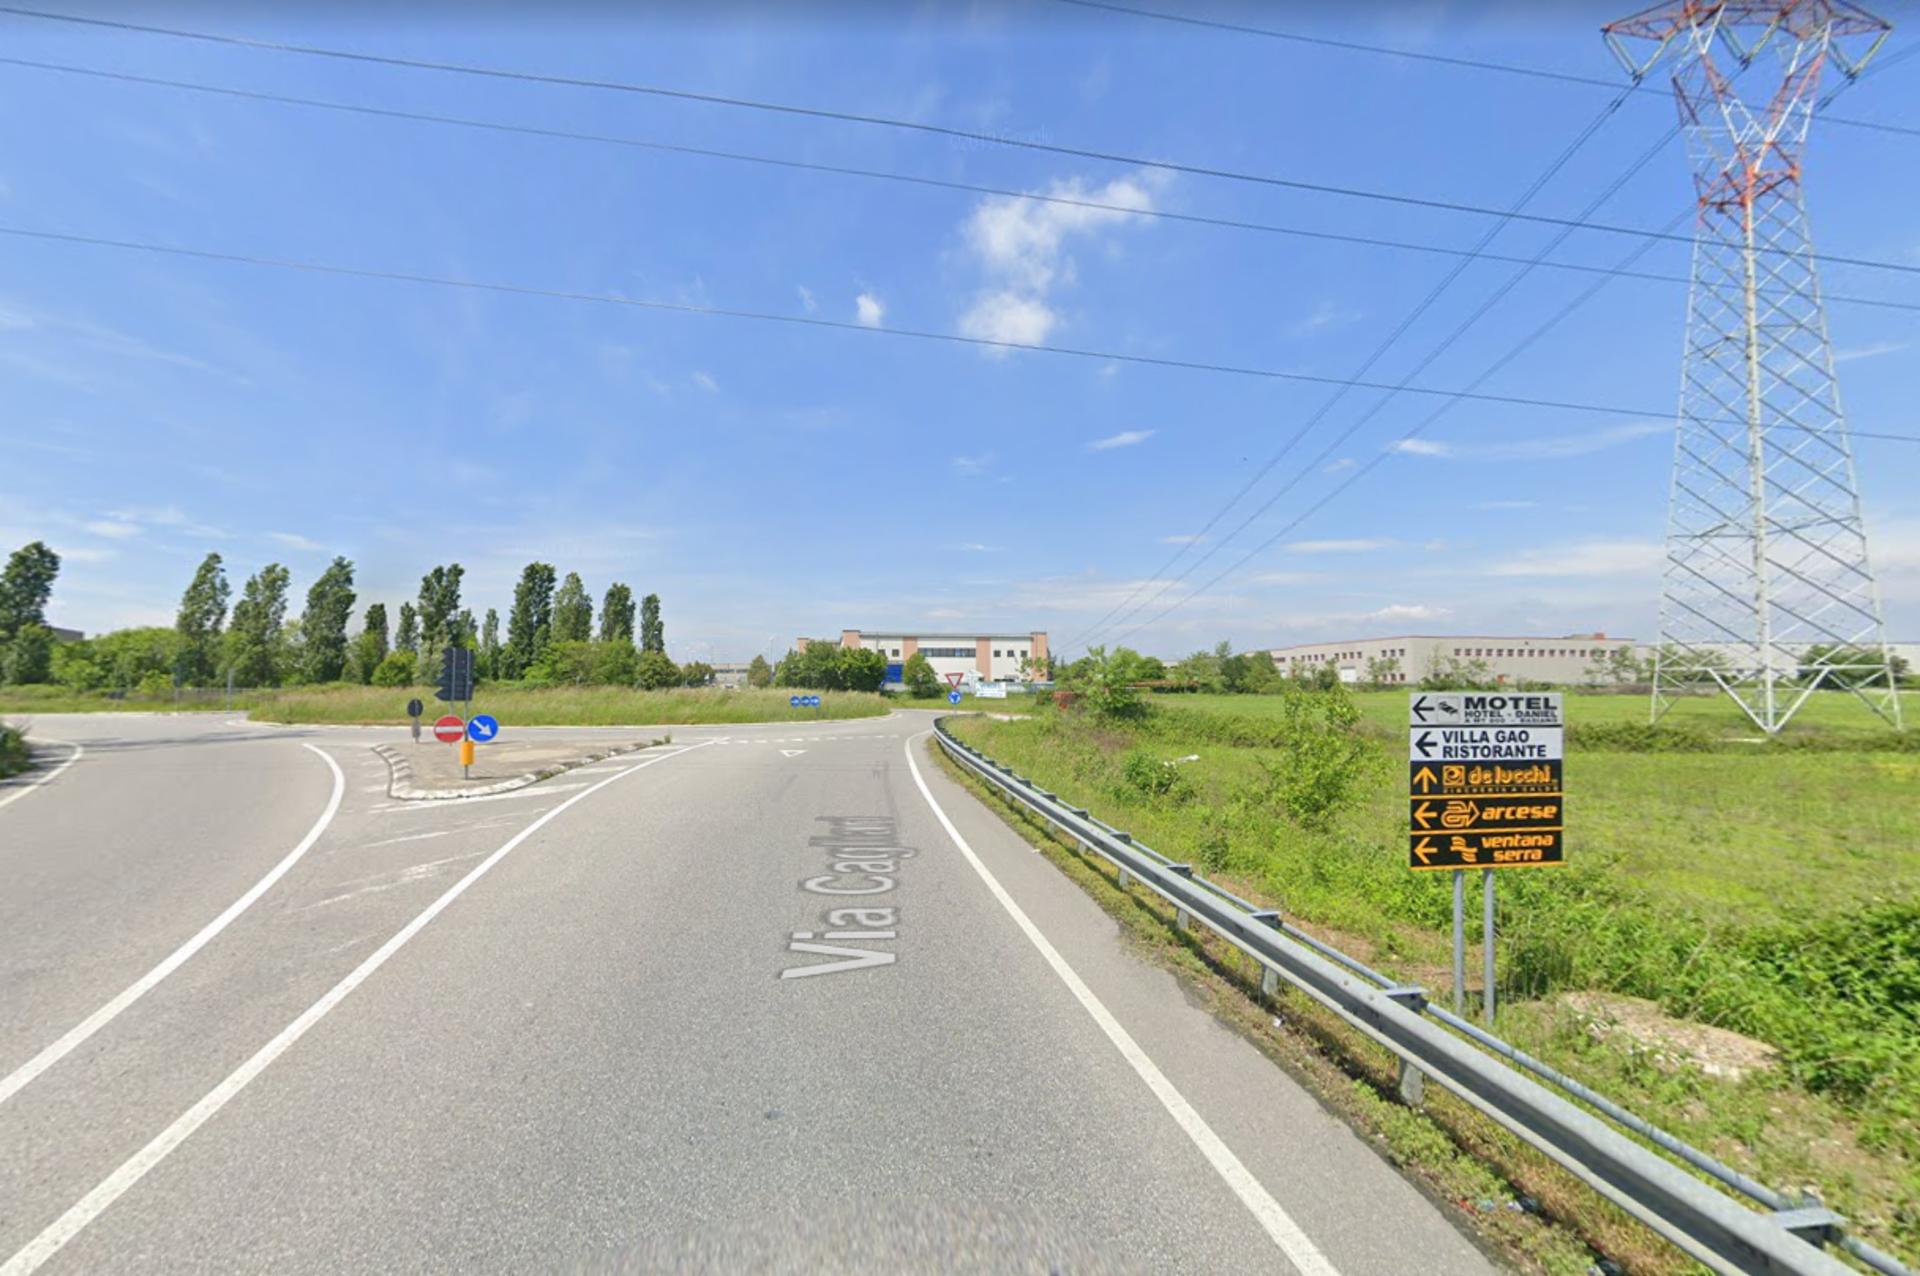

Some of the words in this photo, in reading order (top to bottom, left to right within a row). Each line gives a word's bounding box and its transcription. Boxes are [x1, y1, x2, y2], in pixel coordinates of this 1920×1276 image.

[1464, 697, 1558, 710] MOTEL
[1464, 710, 1504, 718] HOTEL
[1515, 710, 1558, 718] DANIEL
[1442, 730, 1490, 743] VILLA
[1495, 730, 1530, 744] GAO
[1442, 745, 1547, 758] RISTORANTE
[1481, 804, 1557, 820] arcese
[1481, 834, 1554, 848] ventana
[1493, 849, 1543, 862] serra
